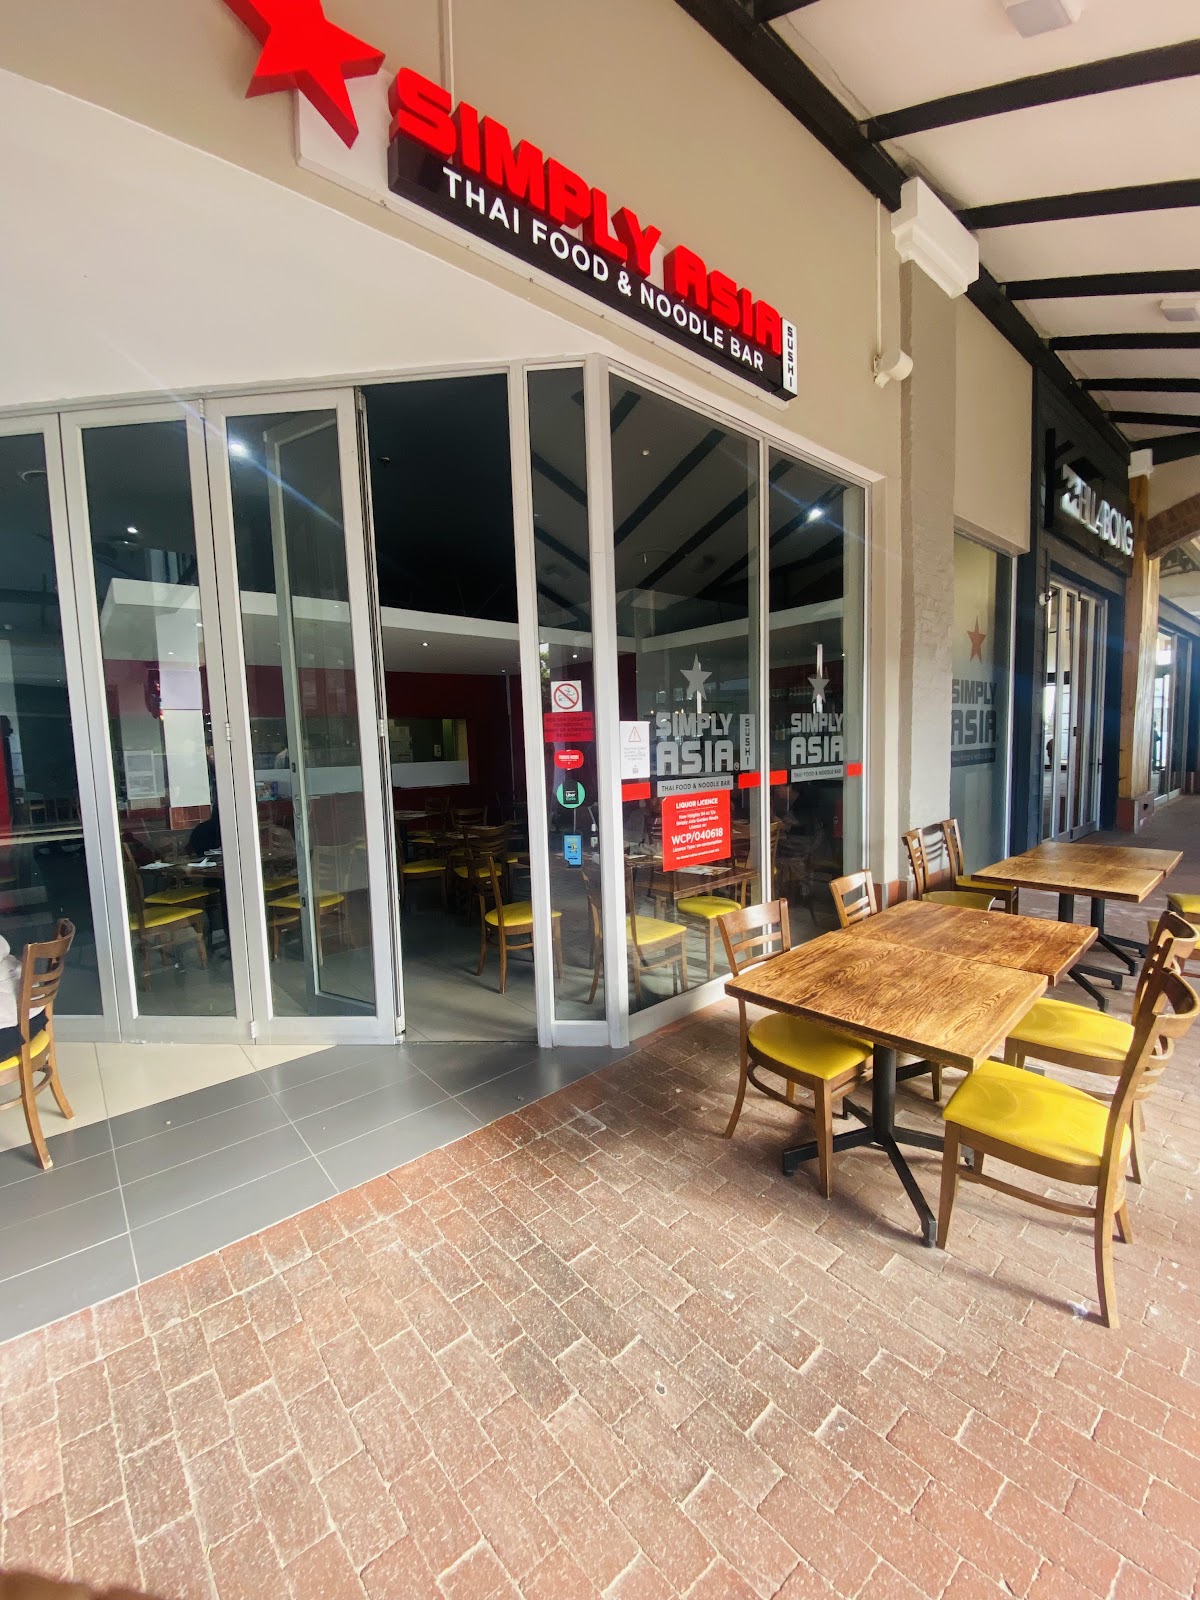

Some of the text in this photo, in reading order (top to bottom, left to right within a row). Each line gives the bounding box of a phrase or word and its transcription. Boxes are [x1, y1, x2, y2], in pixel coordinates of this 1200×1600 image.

[389, 67, 782, 356] SIMPLY ASIA
[442, 166, 764, 372] THAI FOOD & NOODLE BAR
[952, 679, 997, 705] SIMPLY
[655, 712, 733, 737] SIMPLY
[790, 713, 844, 733] SIMPLY
[951, 709, 997, 745] ASIA
[656, 739, 734, 777] ASIA
[790, 735, 844, 766] ASIA
[675, 798, 719, 810] LIQUOR LICENCE
[671, 827, 724, 846] WCP/040618
